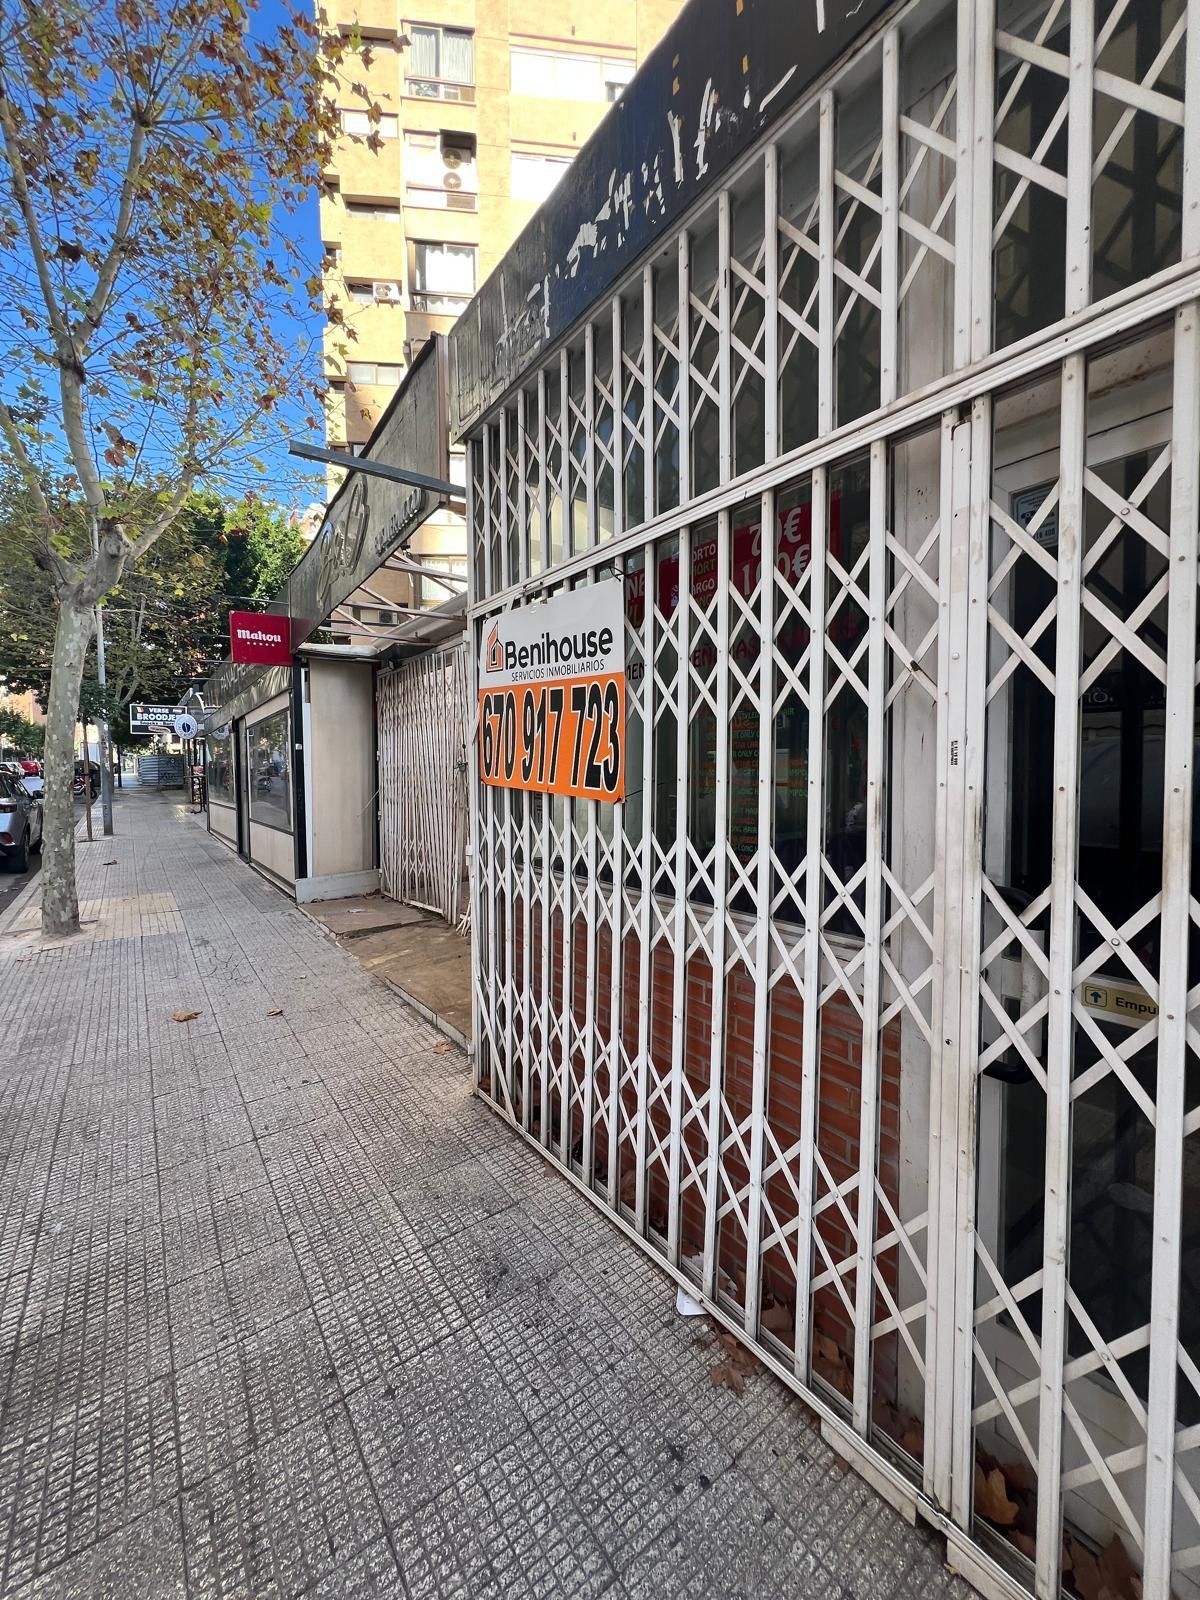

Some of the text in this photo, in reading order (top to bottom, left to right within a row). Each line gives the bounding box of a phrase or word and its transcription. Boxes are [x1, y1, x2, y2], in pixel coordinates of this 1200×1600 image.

[748, 507, 802, 557] 7€
[692, 543, 717, 563] ORTO
[742, 543, 810, 596] 10€
[236, 629, 281, 642] Mahou
[505, 628, 613, 670] Benihouse
[511, 659, 605, 682] SERVICIOS INMOBILIARIOS
[136, 713, 178, 721] BROODJE
[481, 679, 620, 793] 670 917 723
[1115, 997, 1158, 1015] Empu
